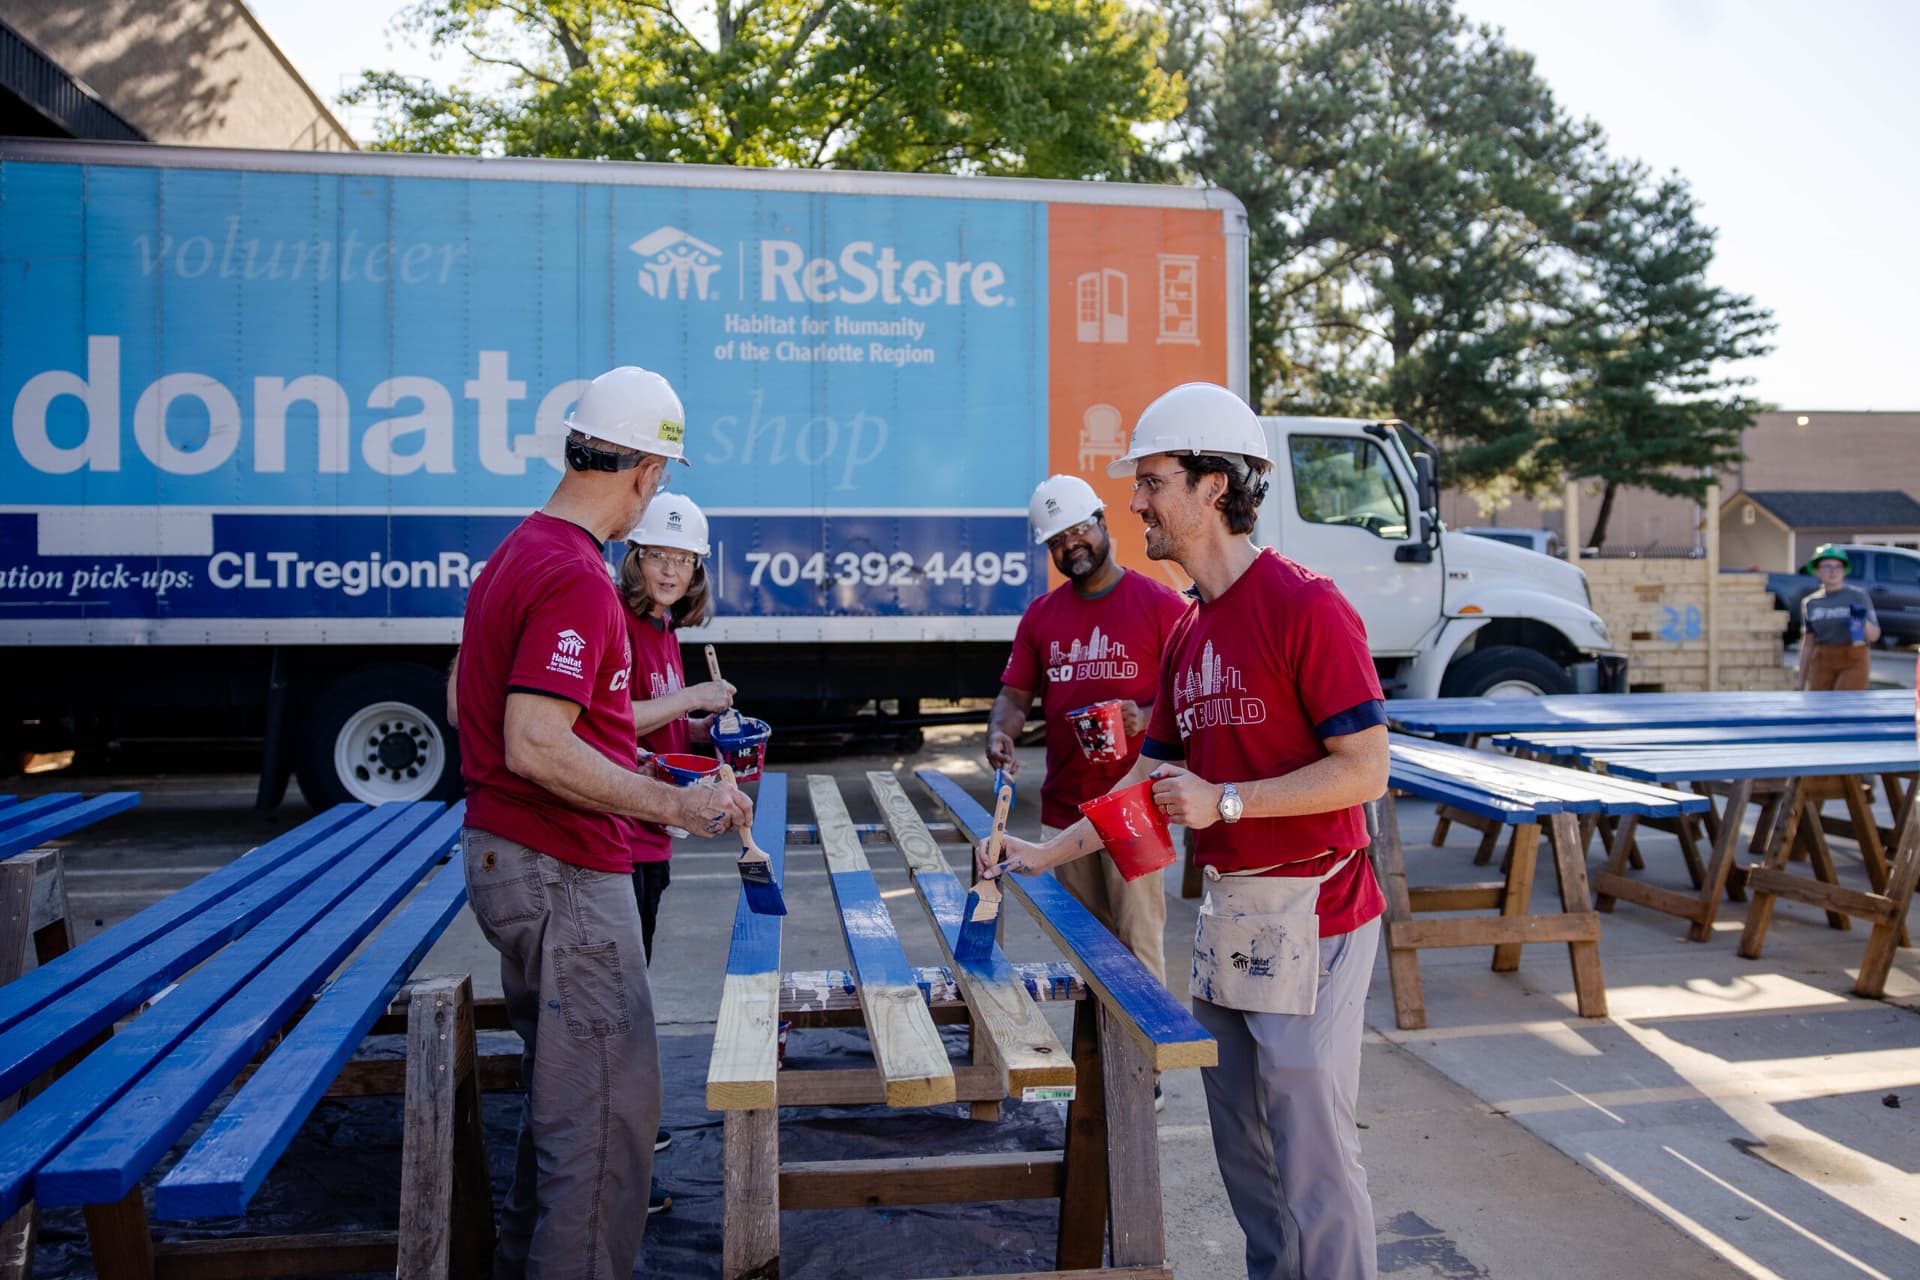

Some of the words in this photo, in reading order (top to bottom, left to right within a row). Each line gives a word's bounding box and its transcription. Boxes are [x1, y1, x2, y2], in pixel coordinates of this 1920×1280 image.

[135, 215, 470, 284] volunteer
[760, 239, 1006, 307] ReStore
[724, 313, 796, 335] Habitat
[801, 315, 829, 335] for
[835, 316, 925, 341] Humanity
[714, 341, 734, 361] of
[740, 342, 769, 361] the
[775, 342, 864, 362] Charlotte
[869, 344, 935, 367] Region
[703, 386, 890, 491] shop
[68, 563, 194, 596] pick-ups:
[552, 652, 582, 668] Habitat
[1047, 664, 1073, 682] EO
[1076, 661, 1138, 681] BUILD
[1175, 707, 1195, 741] EO
[1193, 697, 1267, 730] BUILD
